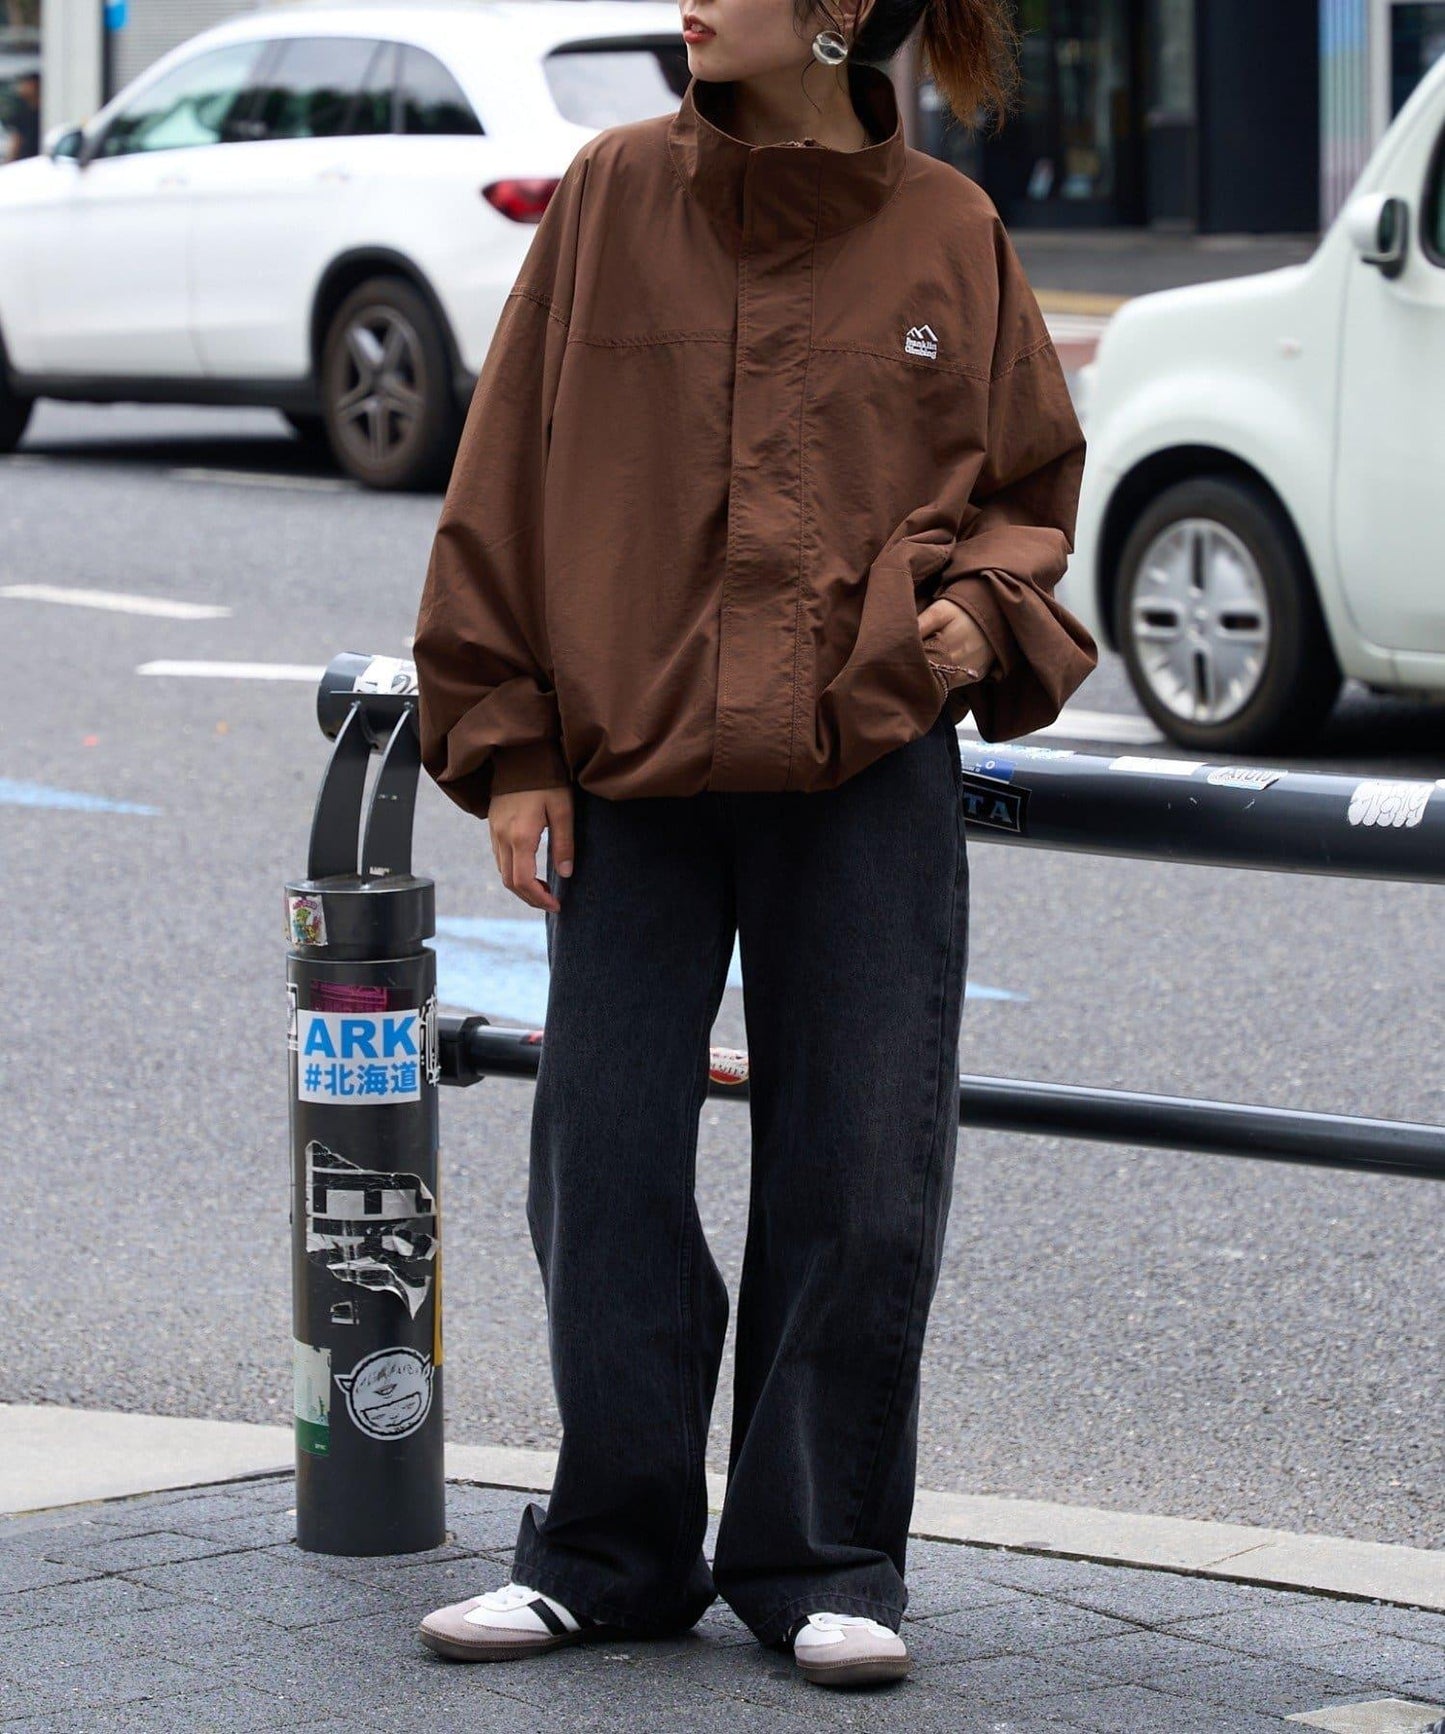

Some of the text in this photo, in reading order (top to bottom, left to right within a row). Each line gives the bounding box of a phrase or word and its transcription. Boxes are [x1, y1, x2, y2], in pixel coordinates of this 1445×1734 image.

[304, 1016, 418, 1058] ARK
[304, 1062, 418, 1096] #北海道
